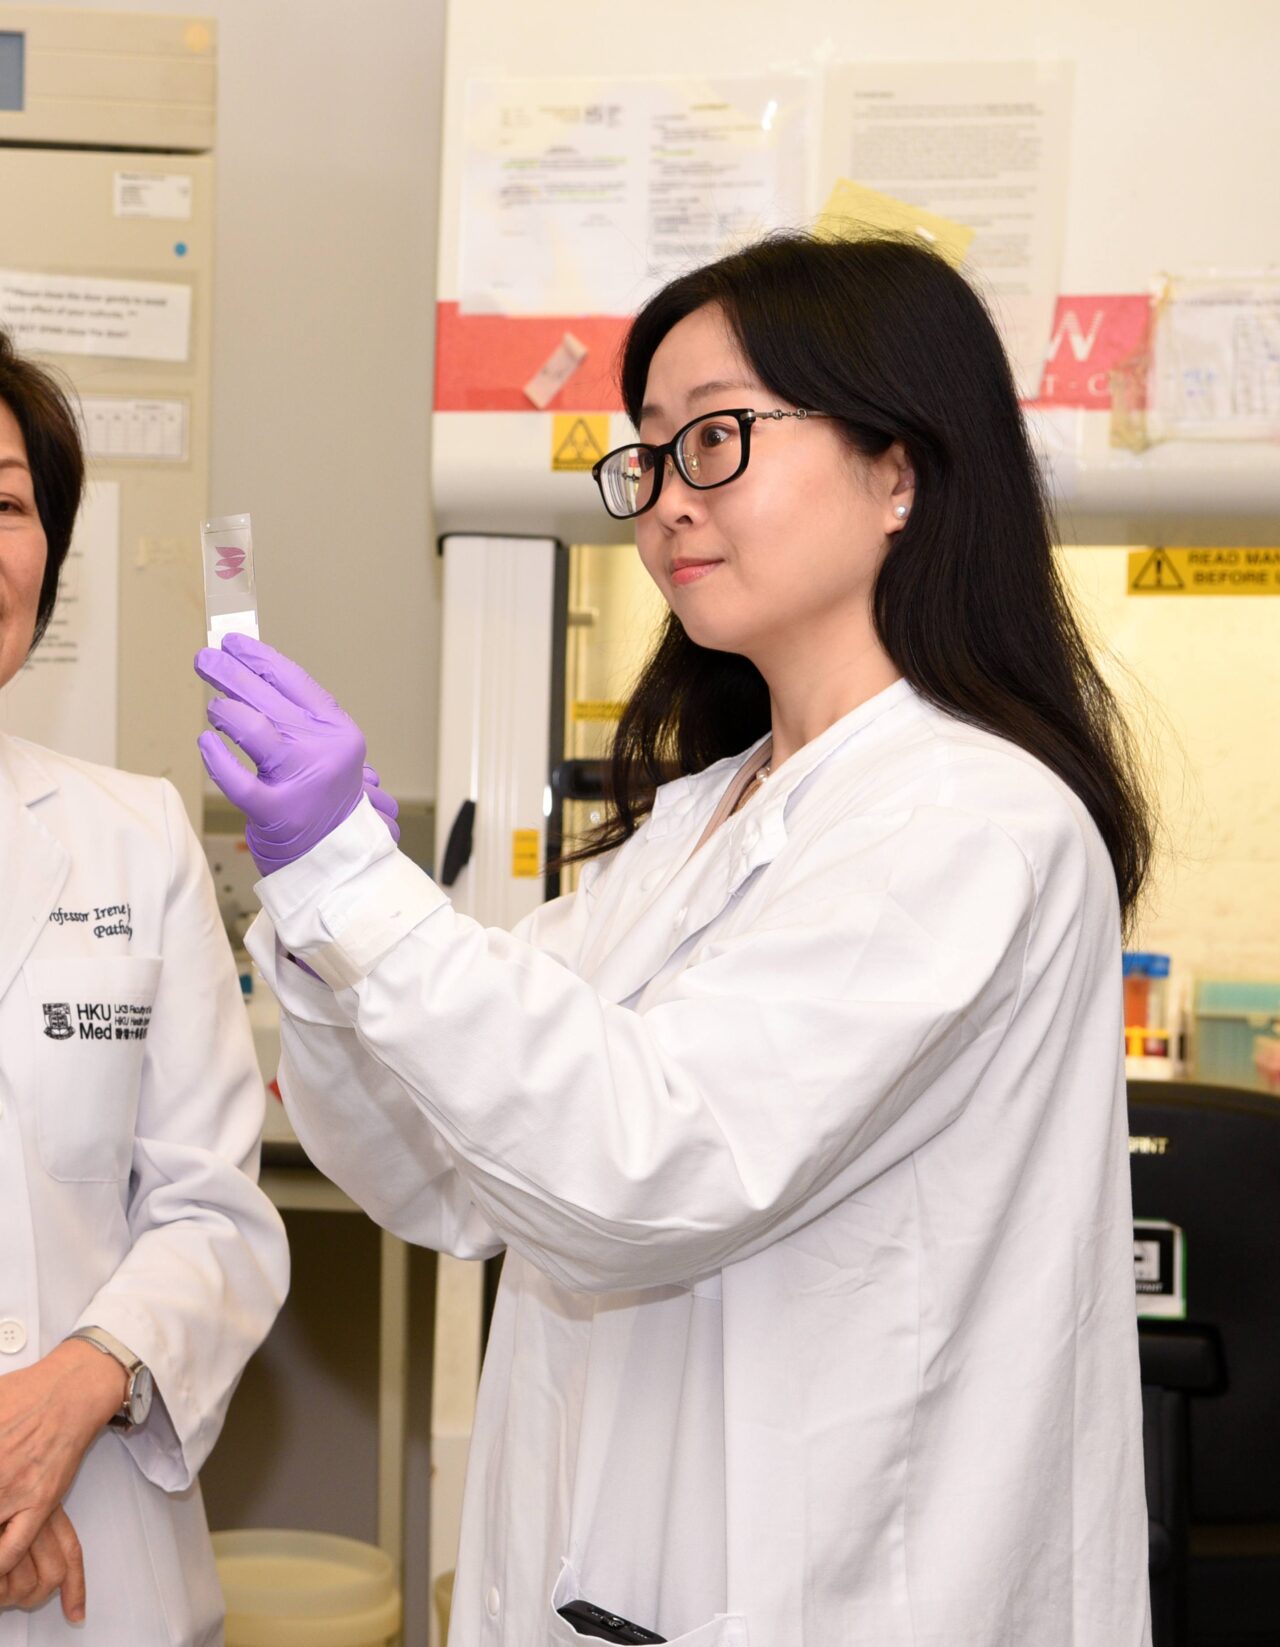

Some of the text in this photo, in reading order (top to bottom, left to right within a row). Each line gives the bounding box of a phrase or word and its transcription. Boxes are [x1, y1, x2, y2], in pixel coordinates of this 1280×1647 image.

[1188, 552, 1240, 565] READ
[1194, 571, 1268, 585] BEFORE
[49, 906, 89, 926] rofessor
[93, 903, 126, 921] Irene
[76, 1003, 111, 1021] HKU
[80, 1022, 112, 1040] Med
